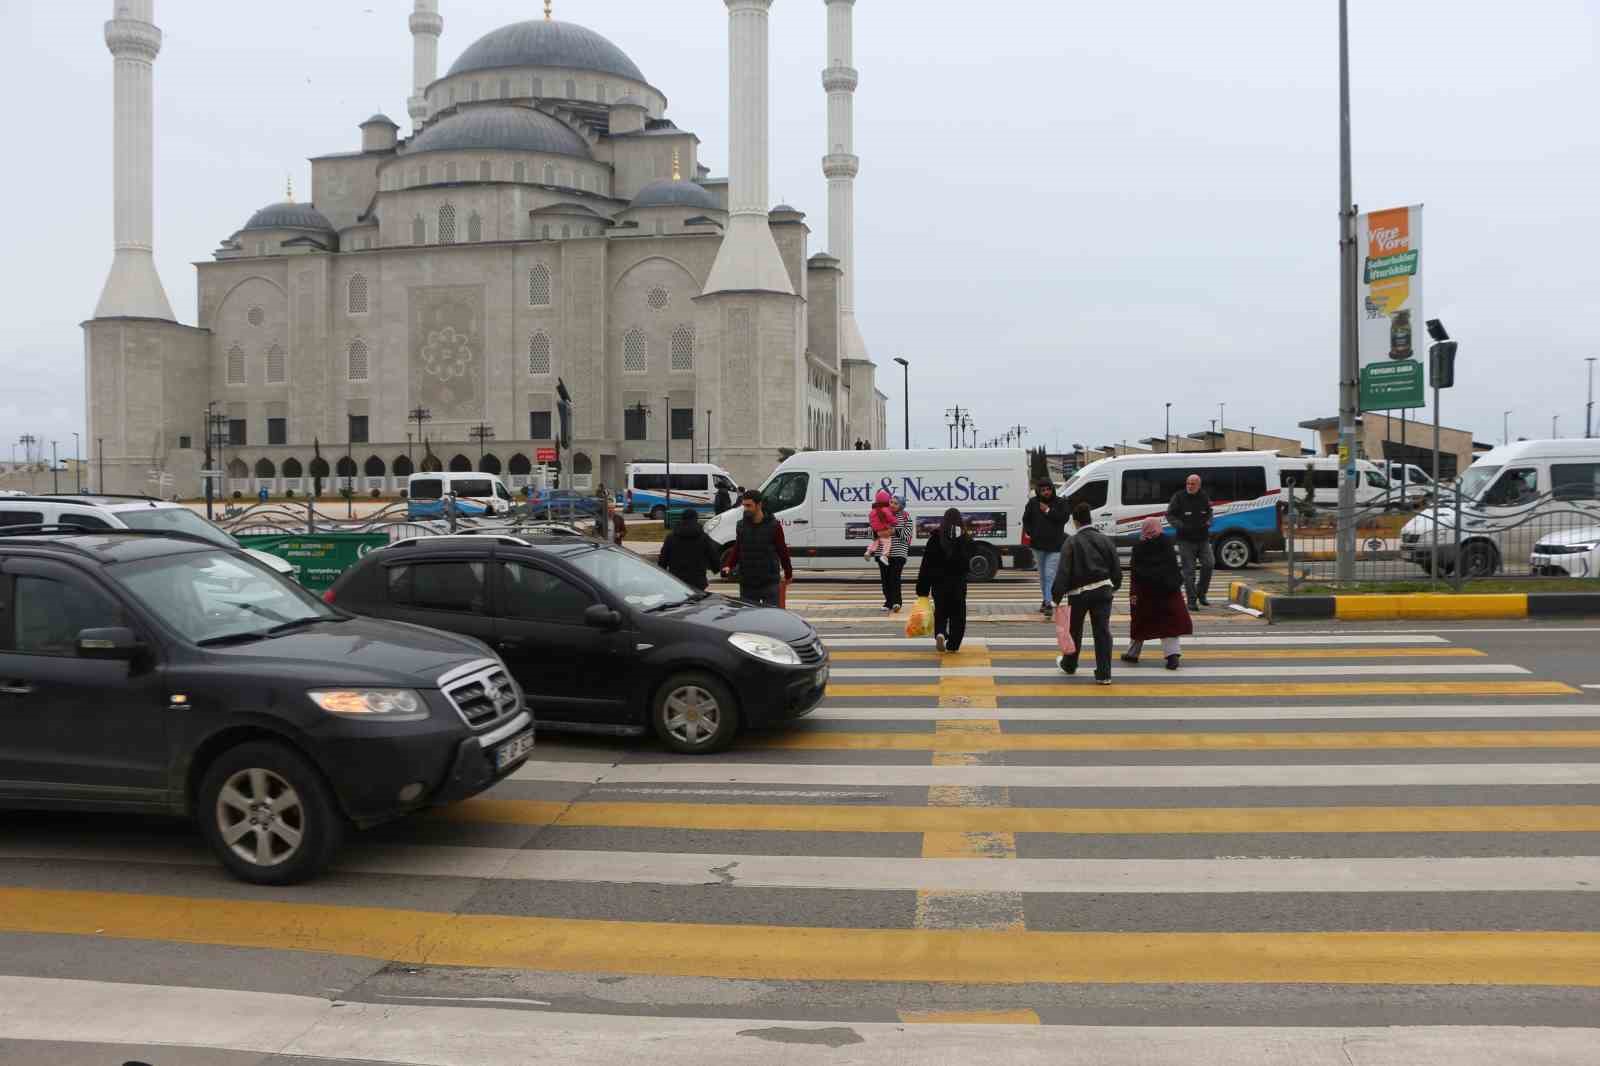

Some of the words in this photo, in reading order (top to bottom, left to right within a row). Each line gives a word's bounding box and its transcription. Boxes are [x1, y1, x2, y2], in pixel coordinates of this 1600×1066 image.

[820, 477, 873, 502] Next
[881, 476, 898, 497] &
[902, 475, 1003, 502] NextStar
